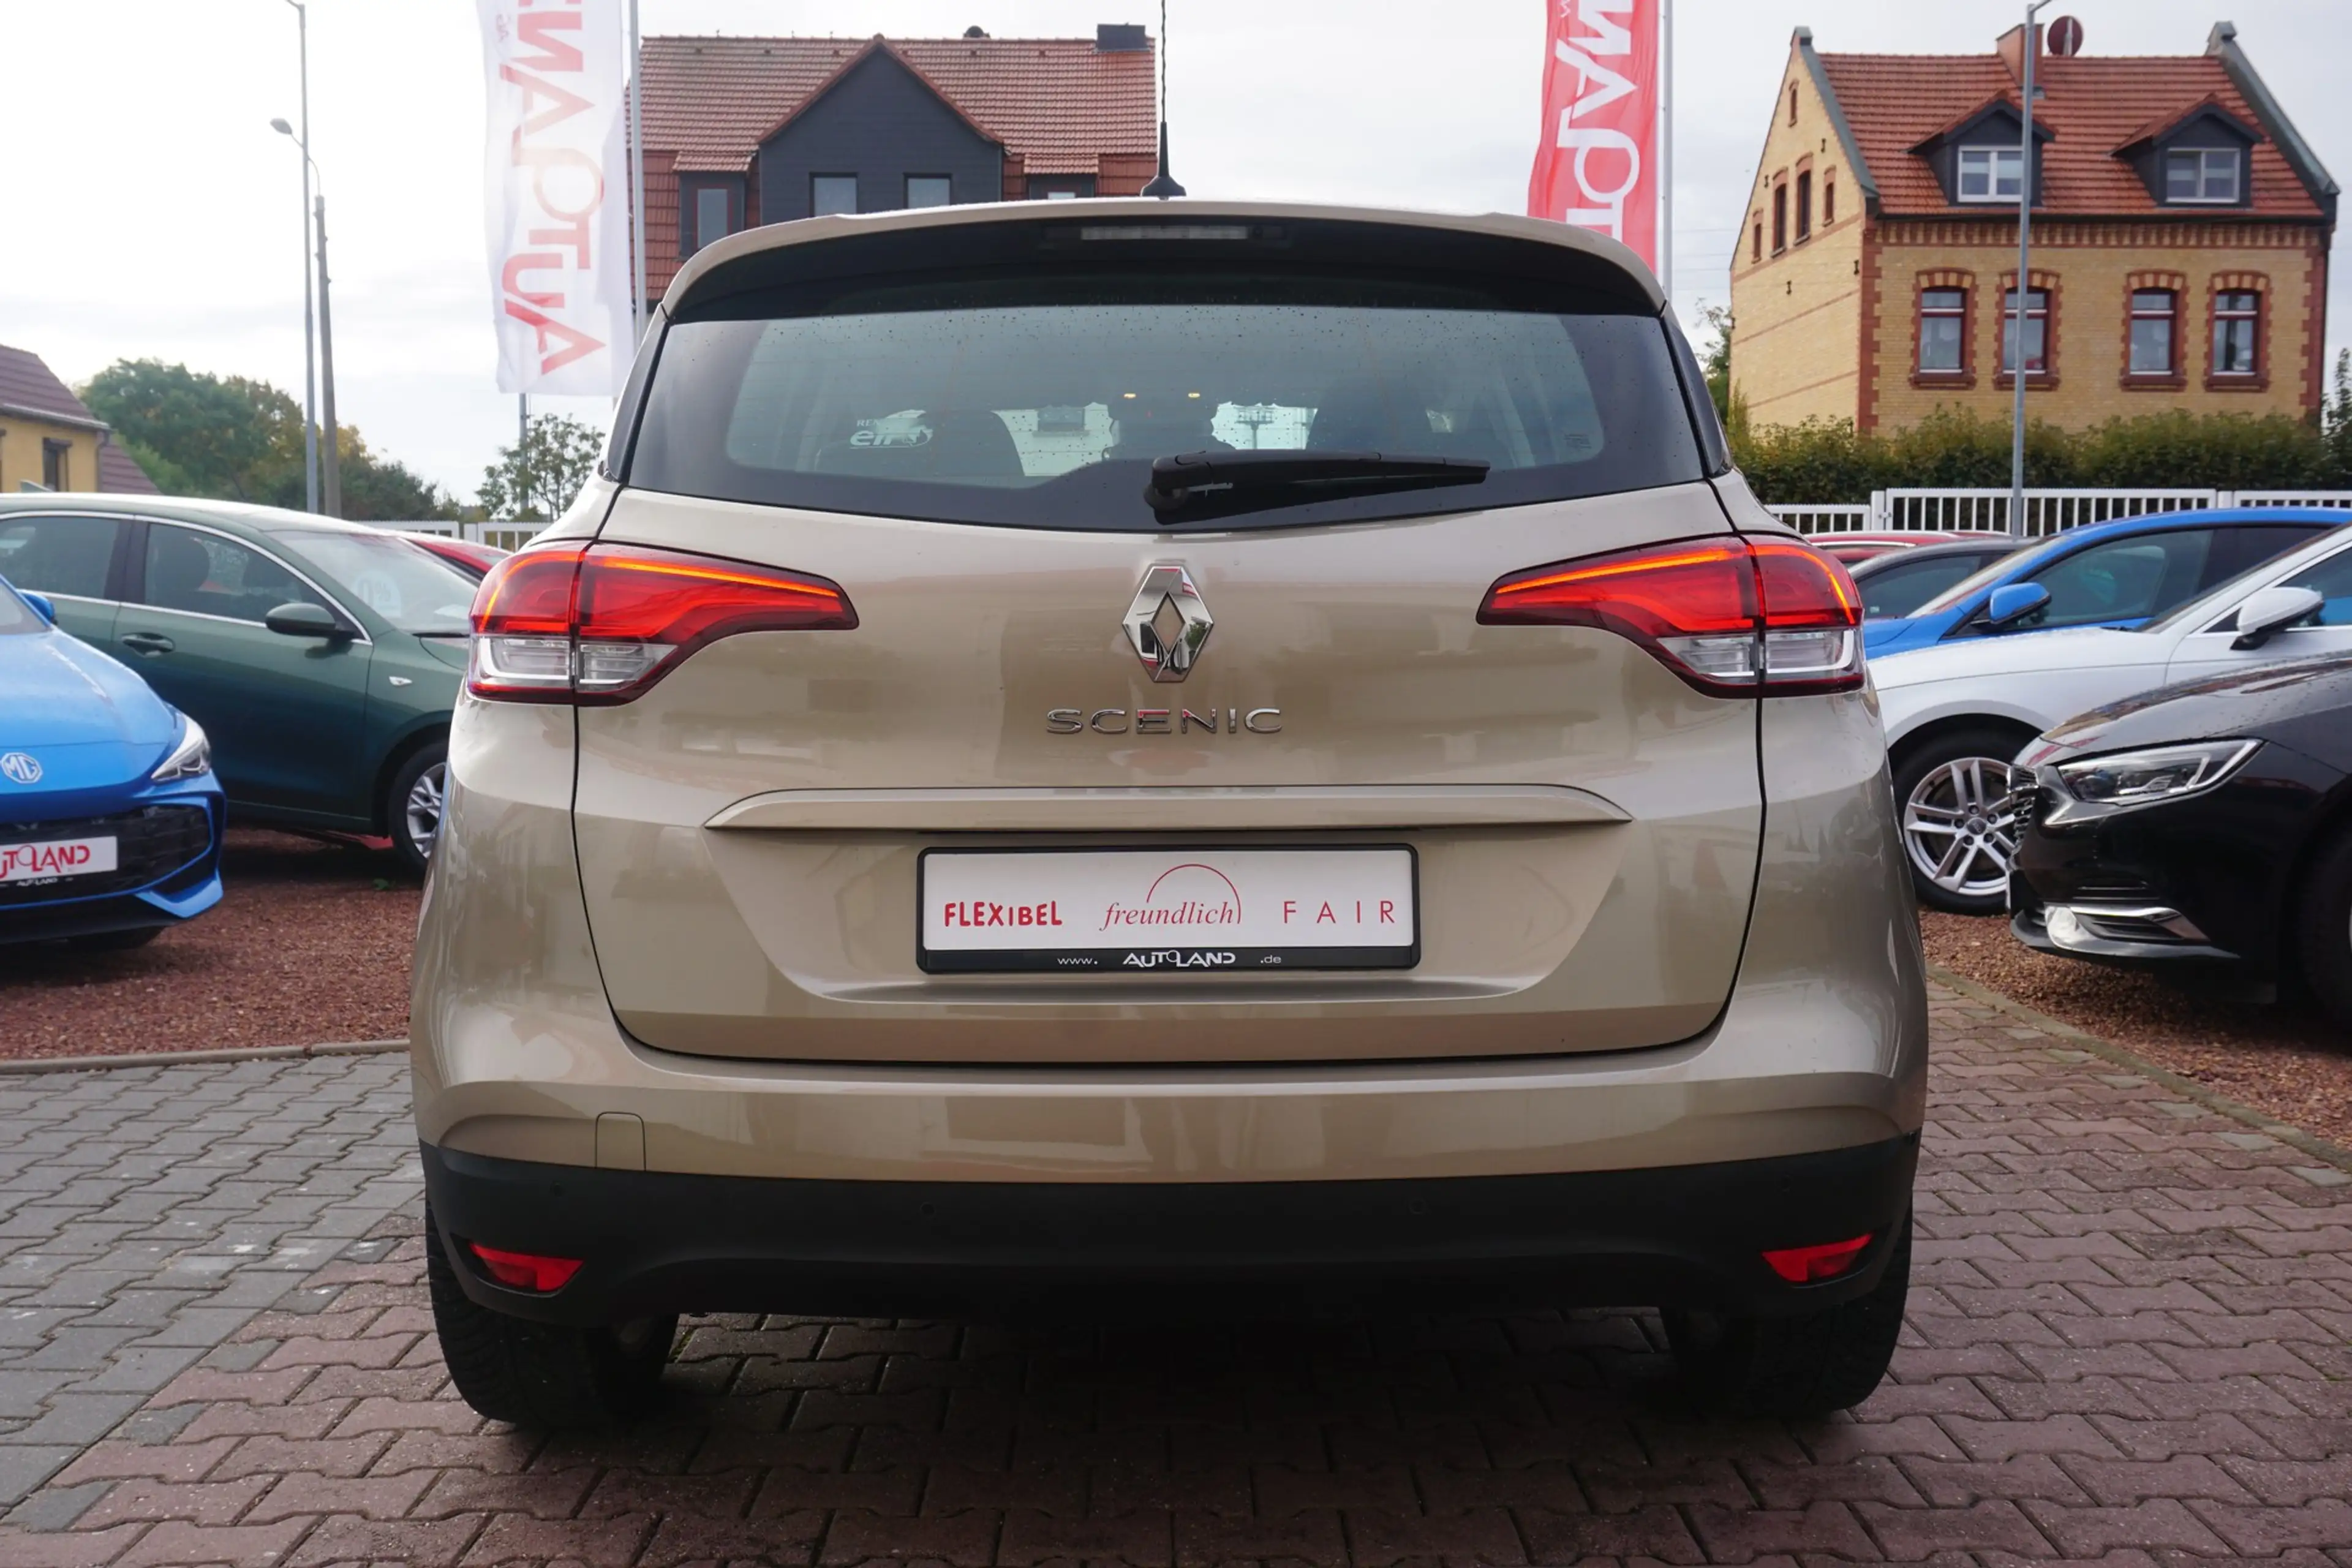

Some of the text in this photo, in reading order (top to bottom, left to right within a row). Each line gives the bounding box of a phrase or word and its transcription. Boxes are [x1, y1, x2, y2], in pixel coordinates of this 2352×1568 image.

[1046, 708, 1283, 735] SCENIC
[2, 753, 42, 783] MG
[944, 900, 1396, 932] FLEXIBEL freundlich FAIR
[1057, 950, 1282, 968] www. AUTOLAND .de
